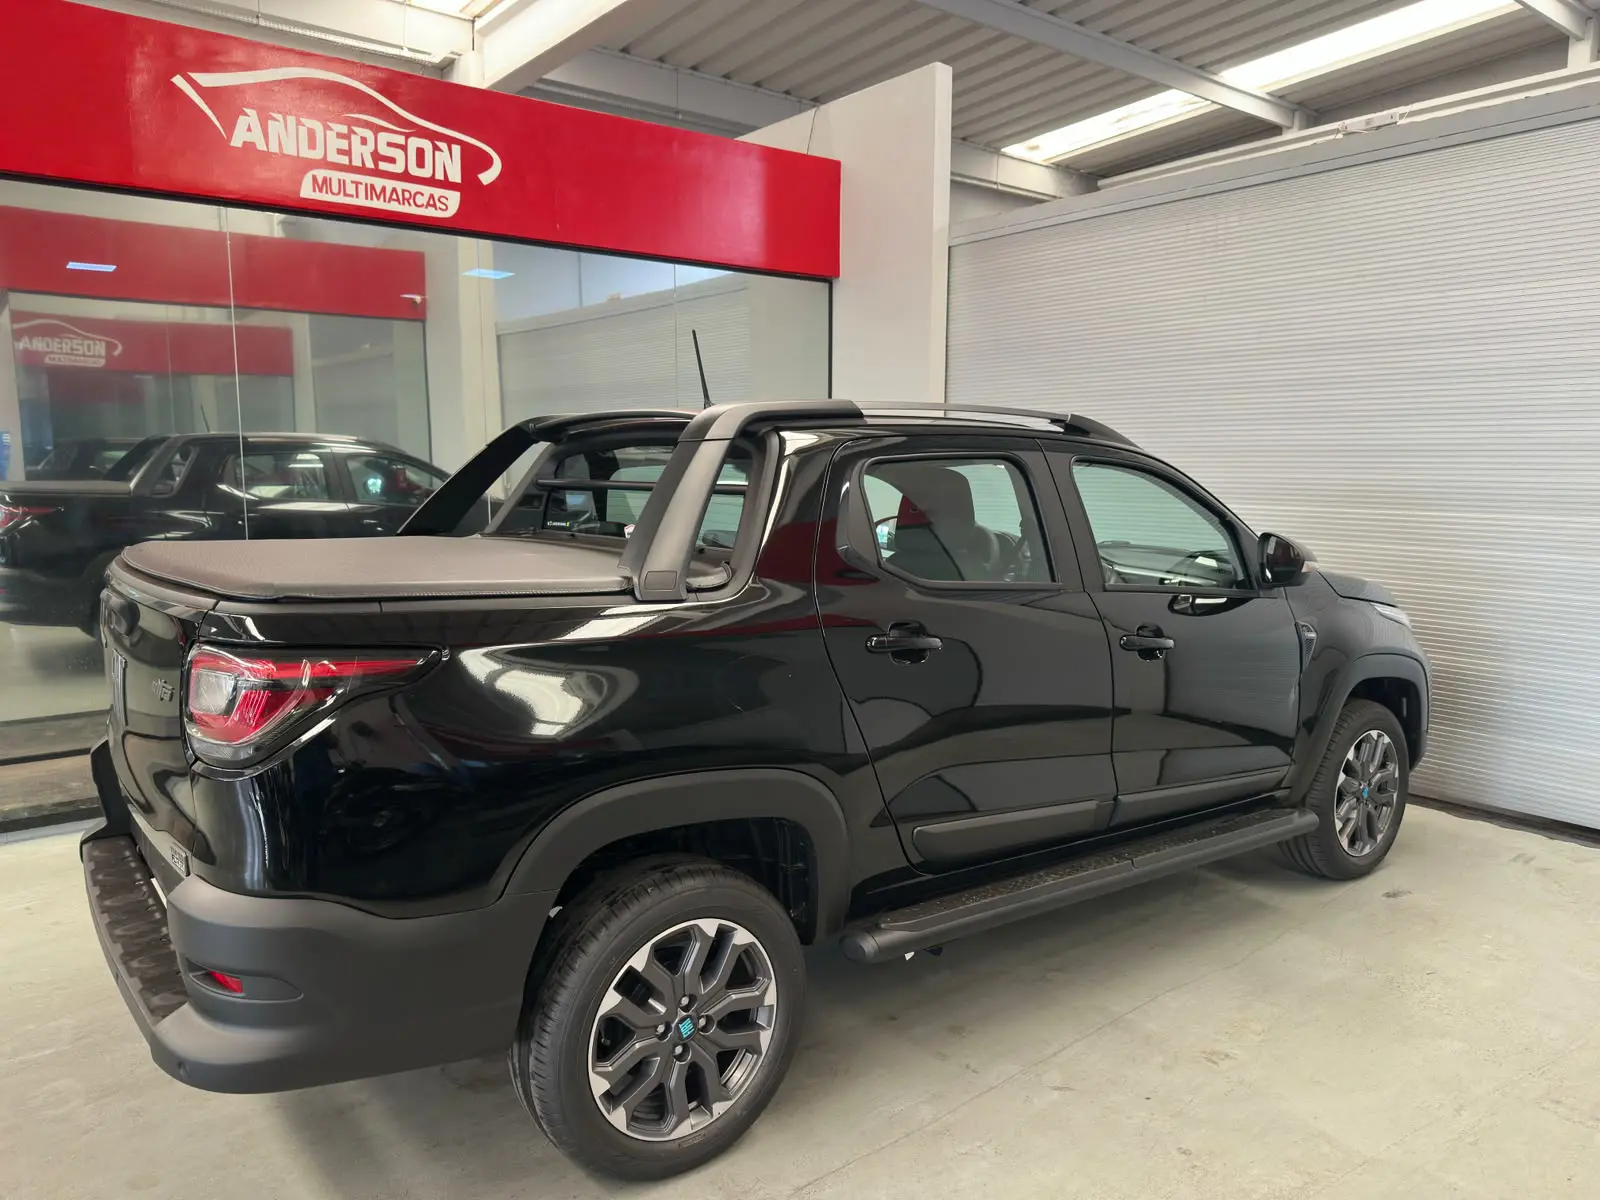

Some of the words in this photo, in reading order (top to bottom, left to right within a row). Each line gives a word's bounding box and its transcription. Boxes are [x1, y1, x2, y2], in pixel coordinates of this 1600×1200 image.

[230, 108, 461, 183] ANDERSON
[311, 174, 449, 212] MULTIMARCAS
[20, 335, 106, 356] ANDERSON
